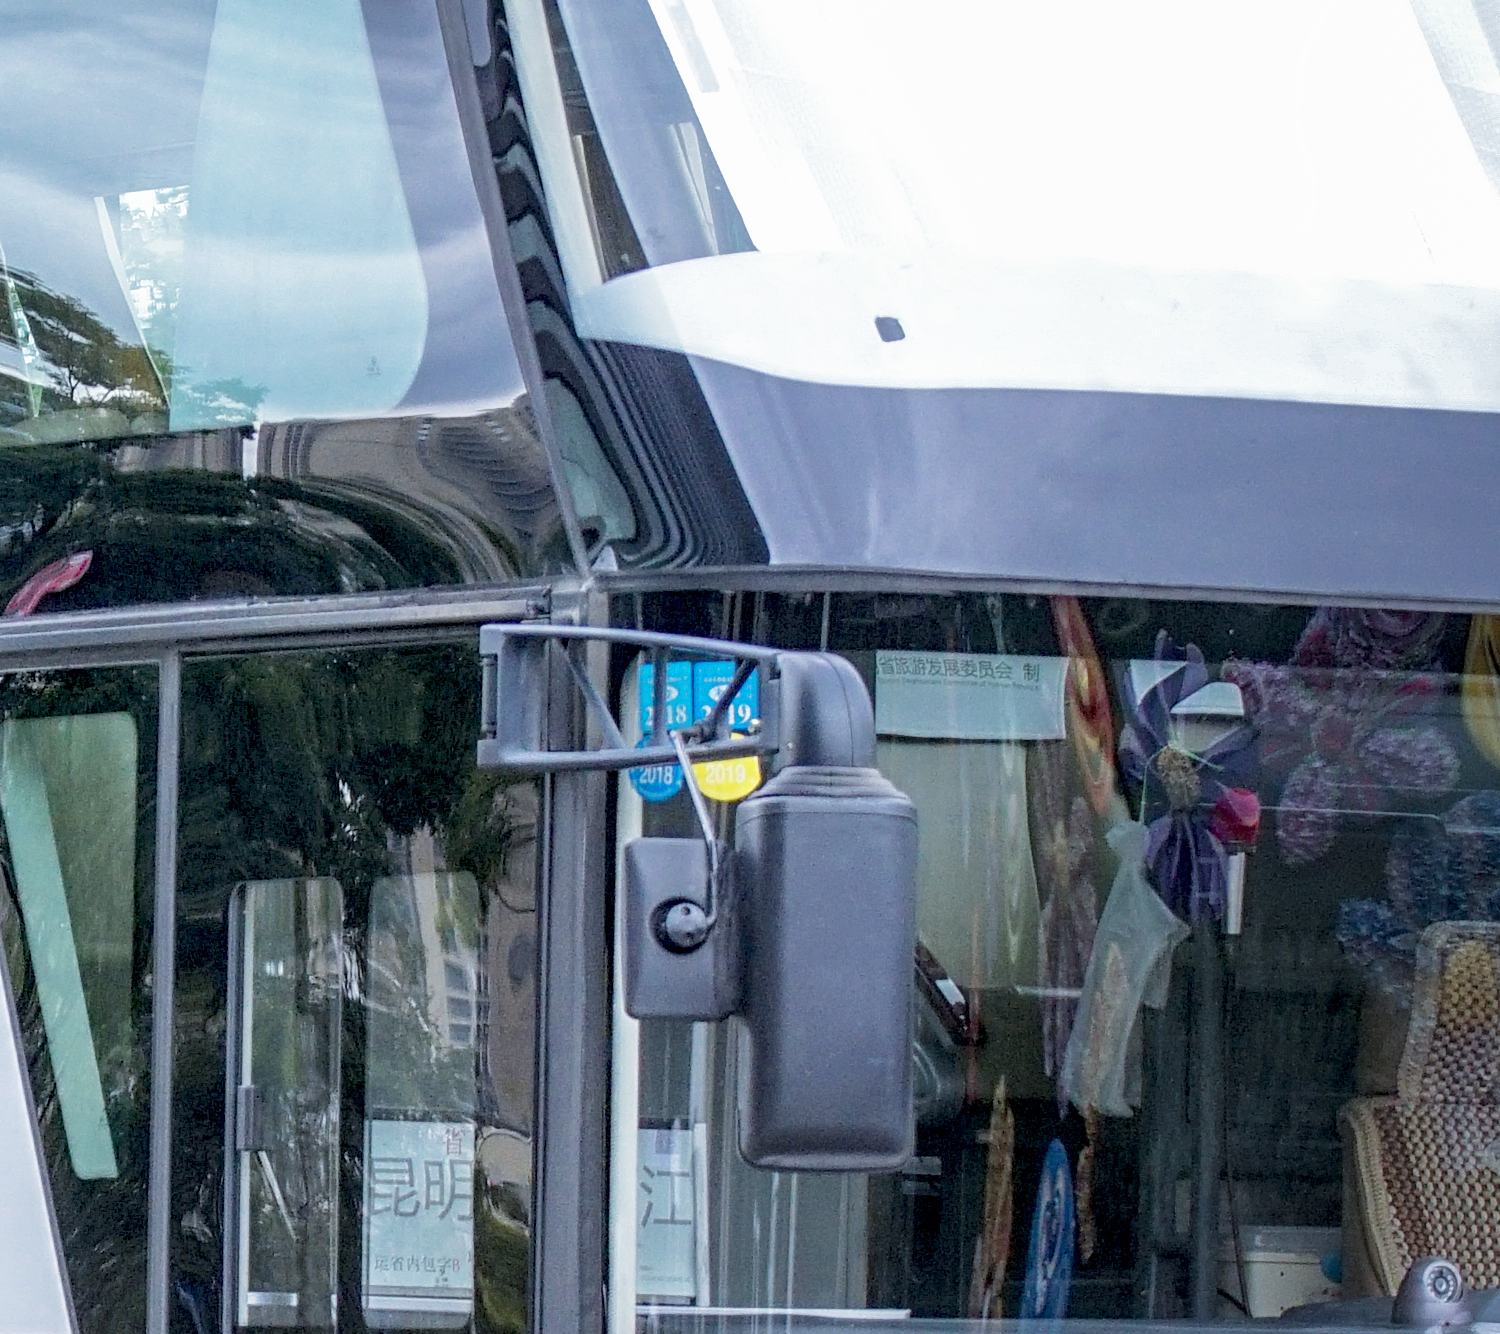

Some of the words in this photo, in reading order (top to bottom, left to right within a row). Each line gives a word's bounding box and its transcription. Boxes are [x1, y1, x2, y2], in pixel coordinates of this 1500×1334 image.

[645, 704, 687, 725] 218
[701, 704, 752, 726] 219
[639, 766, 674, 785] 2018
[705, 764, 747, 785] 2019
[370, 1157, 474, 1221] 昆明
